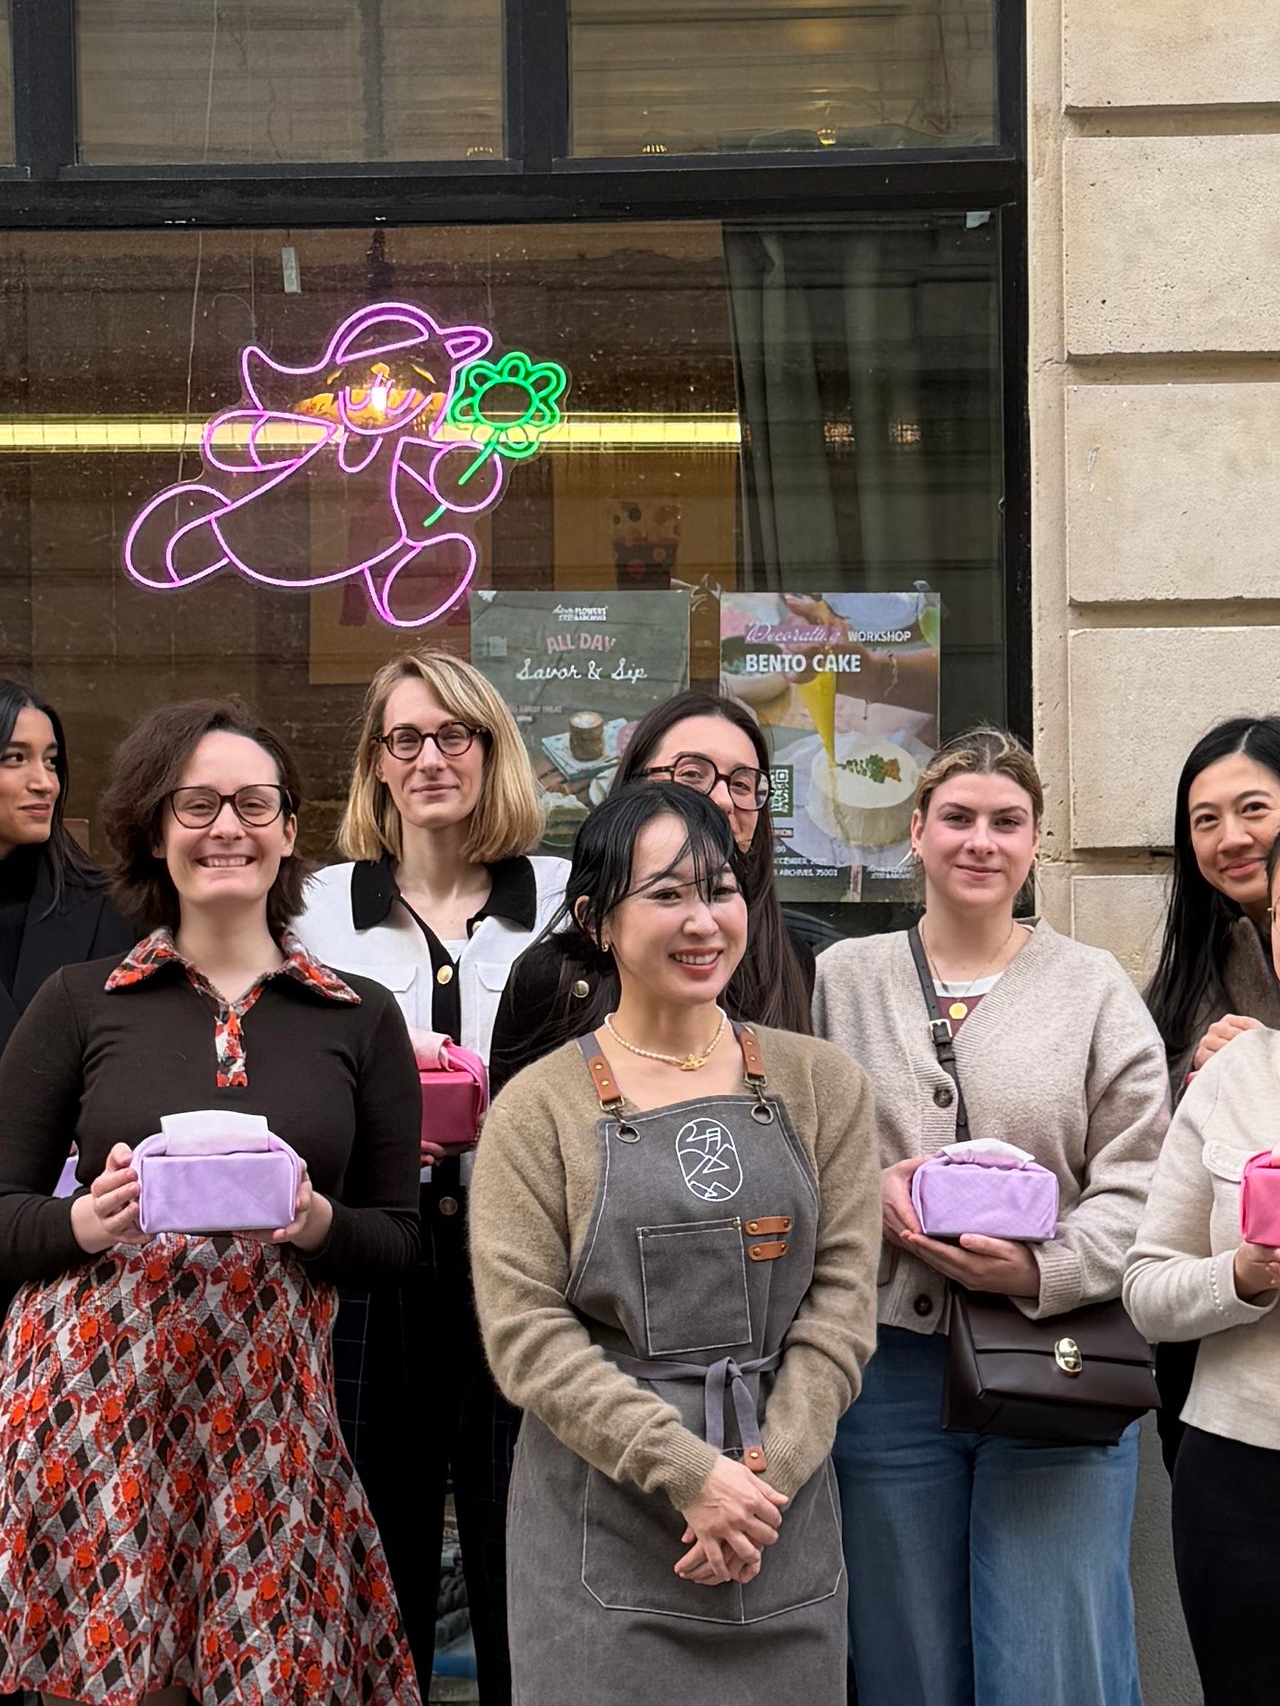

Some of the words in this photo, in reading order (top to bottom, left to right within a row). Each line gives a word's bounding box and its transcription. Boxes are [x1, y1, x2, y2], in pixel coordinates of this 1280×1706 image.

[546, 634, 576, 654] ALL
[579, 632, 617, 652] DAY
[847, 630, 912, 643] WORKSHOP
[516, 658, 582, 680] Savor
[587, 660, 604, 681] &
[610, 658, 648, 685] Sip
[745, 654, 807, 672] BENTO
[812, 654, 862, 672] CAKE
